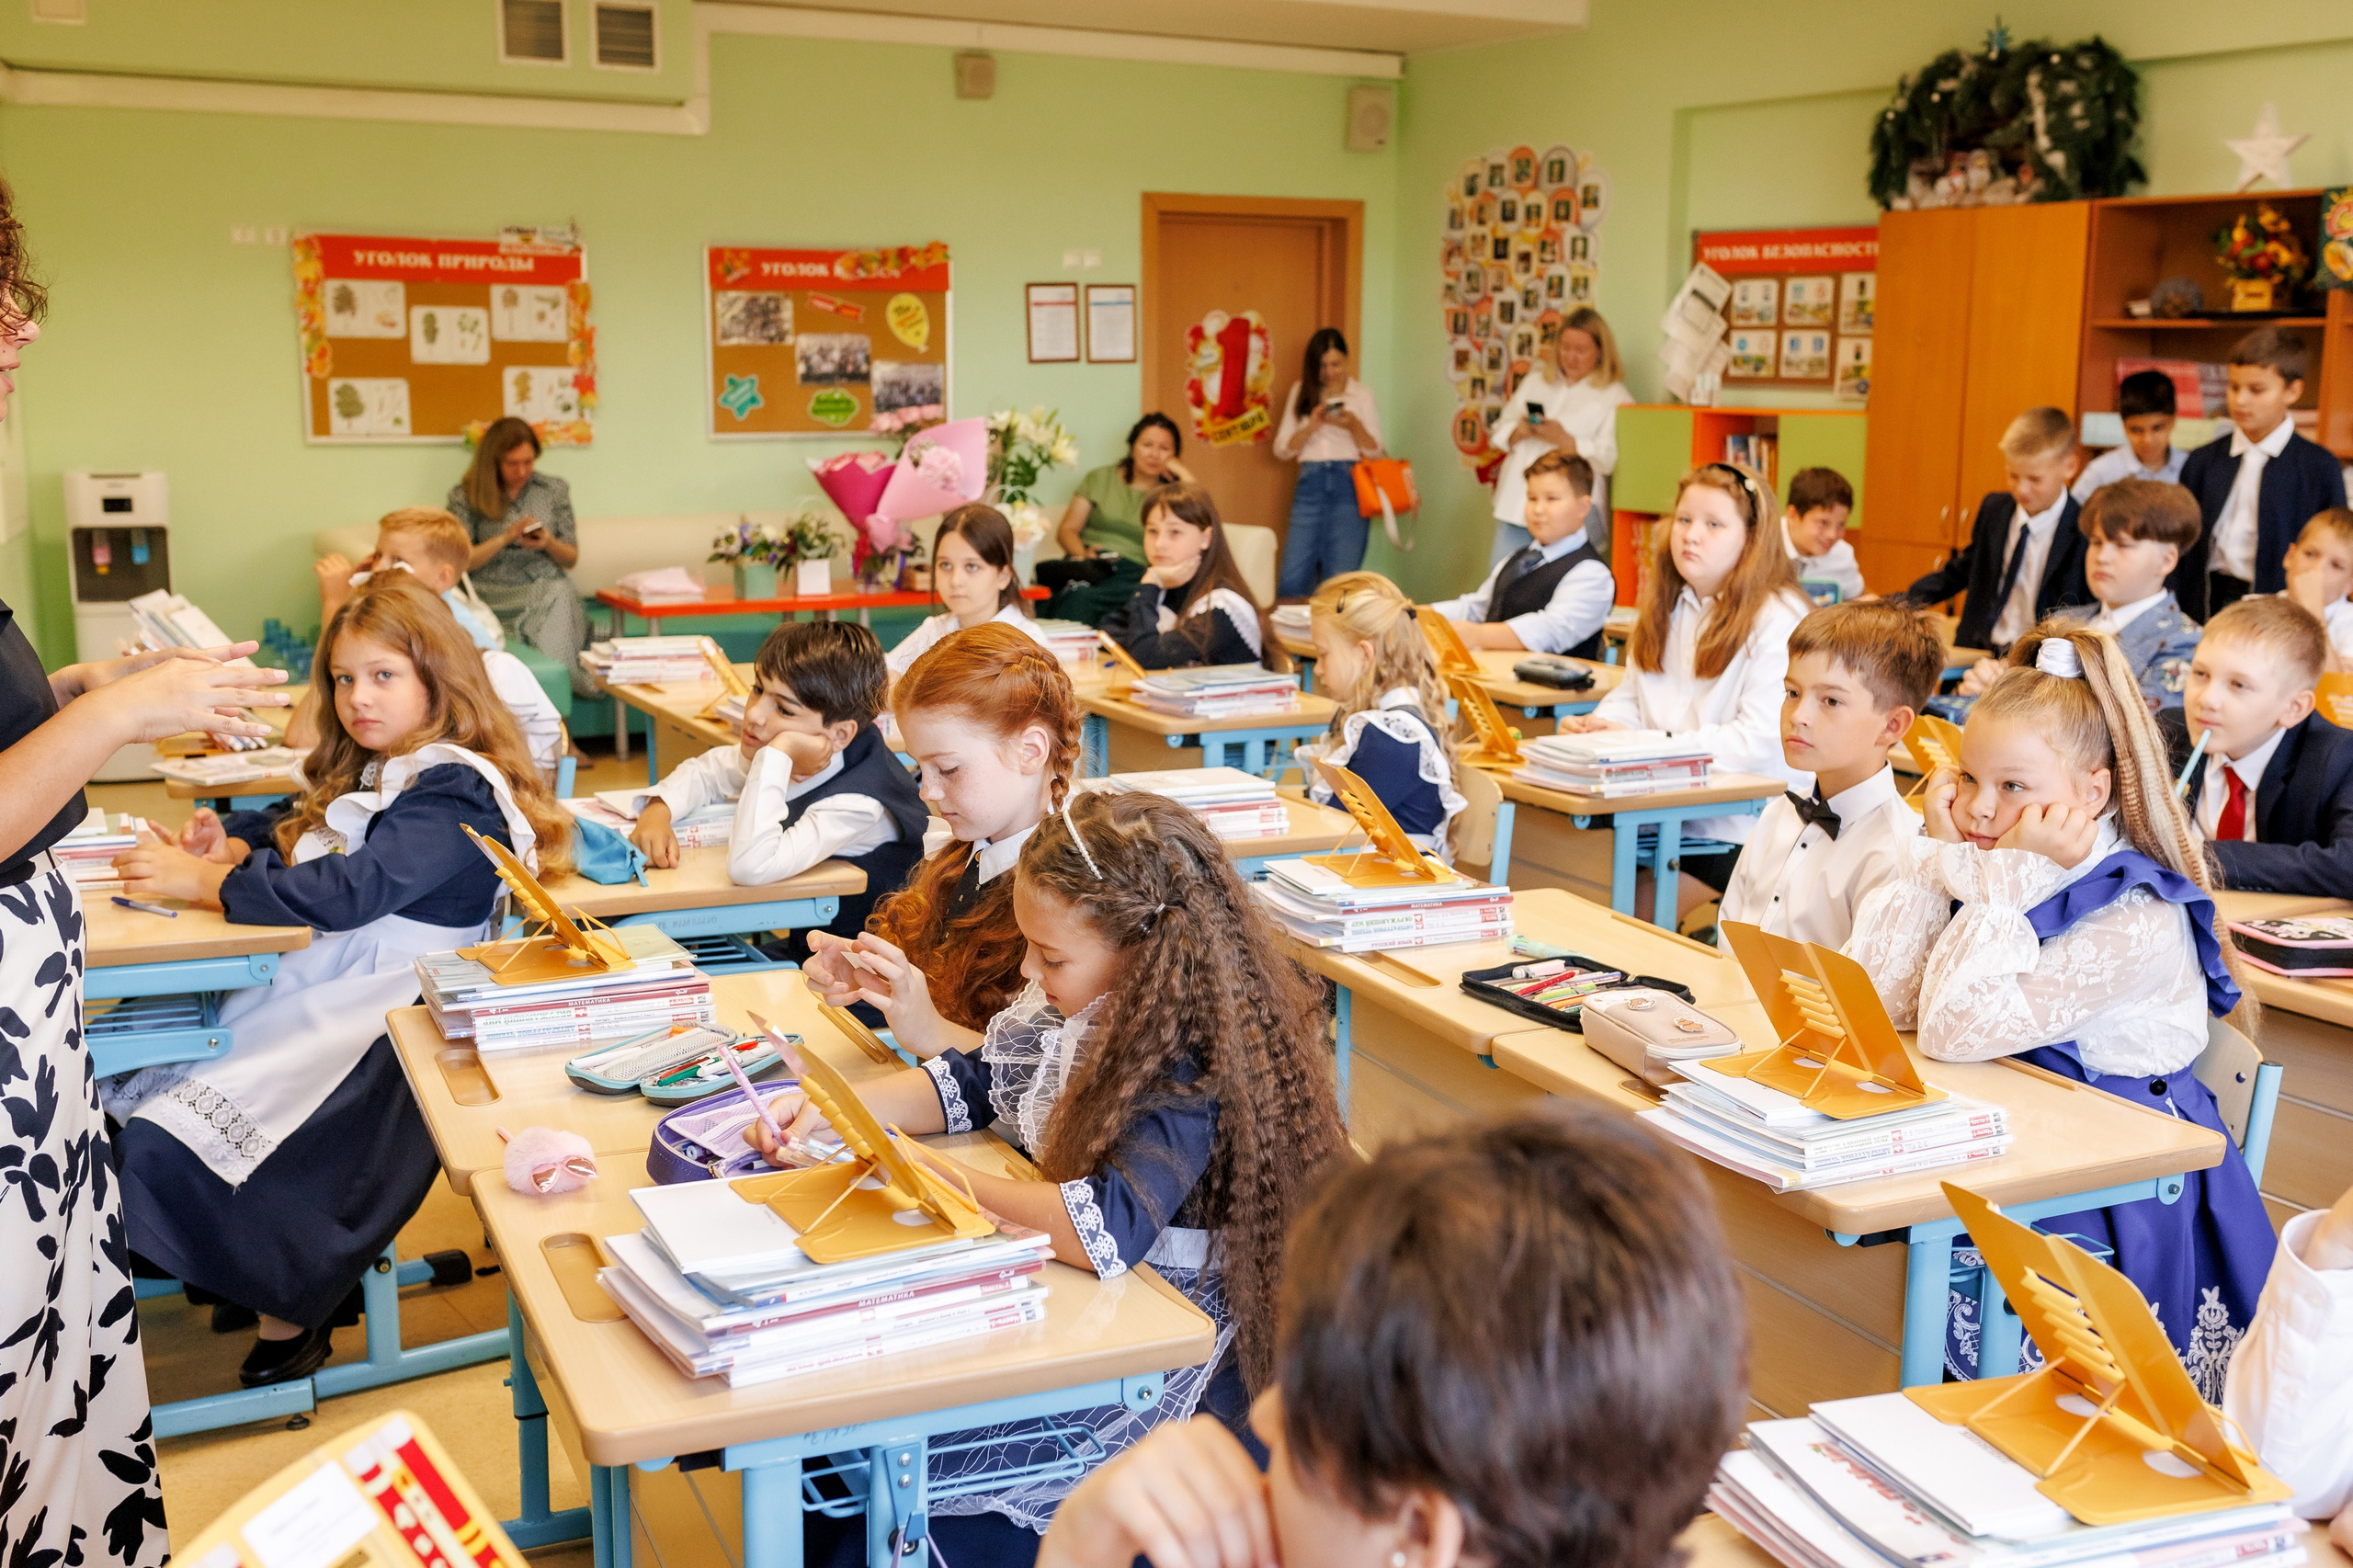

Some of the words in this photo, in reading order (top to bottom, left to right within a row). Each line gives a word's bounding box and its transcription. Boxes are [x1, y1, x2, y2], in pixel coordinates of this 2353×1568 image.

[354, 250, 432, 268] УГОЛОК
[438, 253, 534, 271] ПРИРОДЫ
[1702, 244, 1758, 263] УГОЛОК
[761, 262, 828, 278] УГОЛОК
[1216, 318, 1250, 418] 1
[568, 997, 611, 1007] МАТЕМАТИКА
[483, 1016, 503, 1027] МИР
[503, 1009, 573, 1025] ОКРУЖАЮЩИЙ
[858, 1290, 915, 1308] МАТЕМАТИКА
